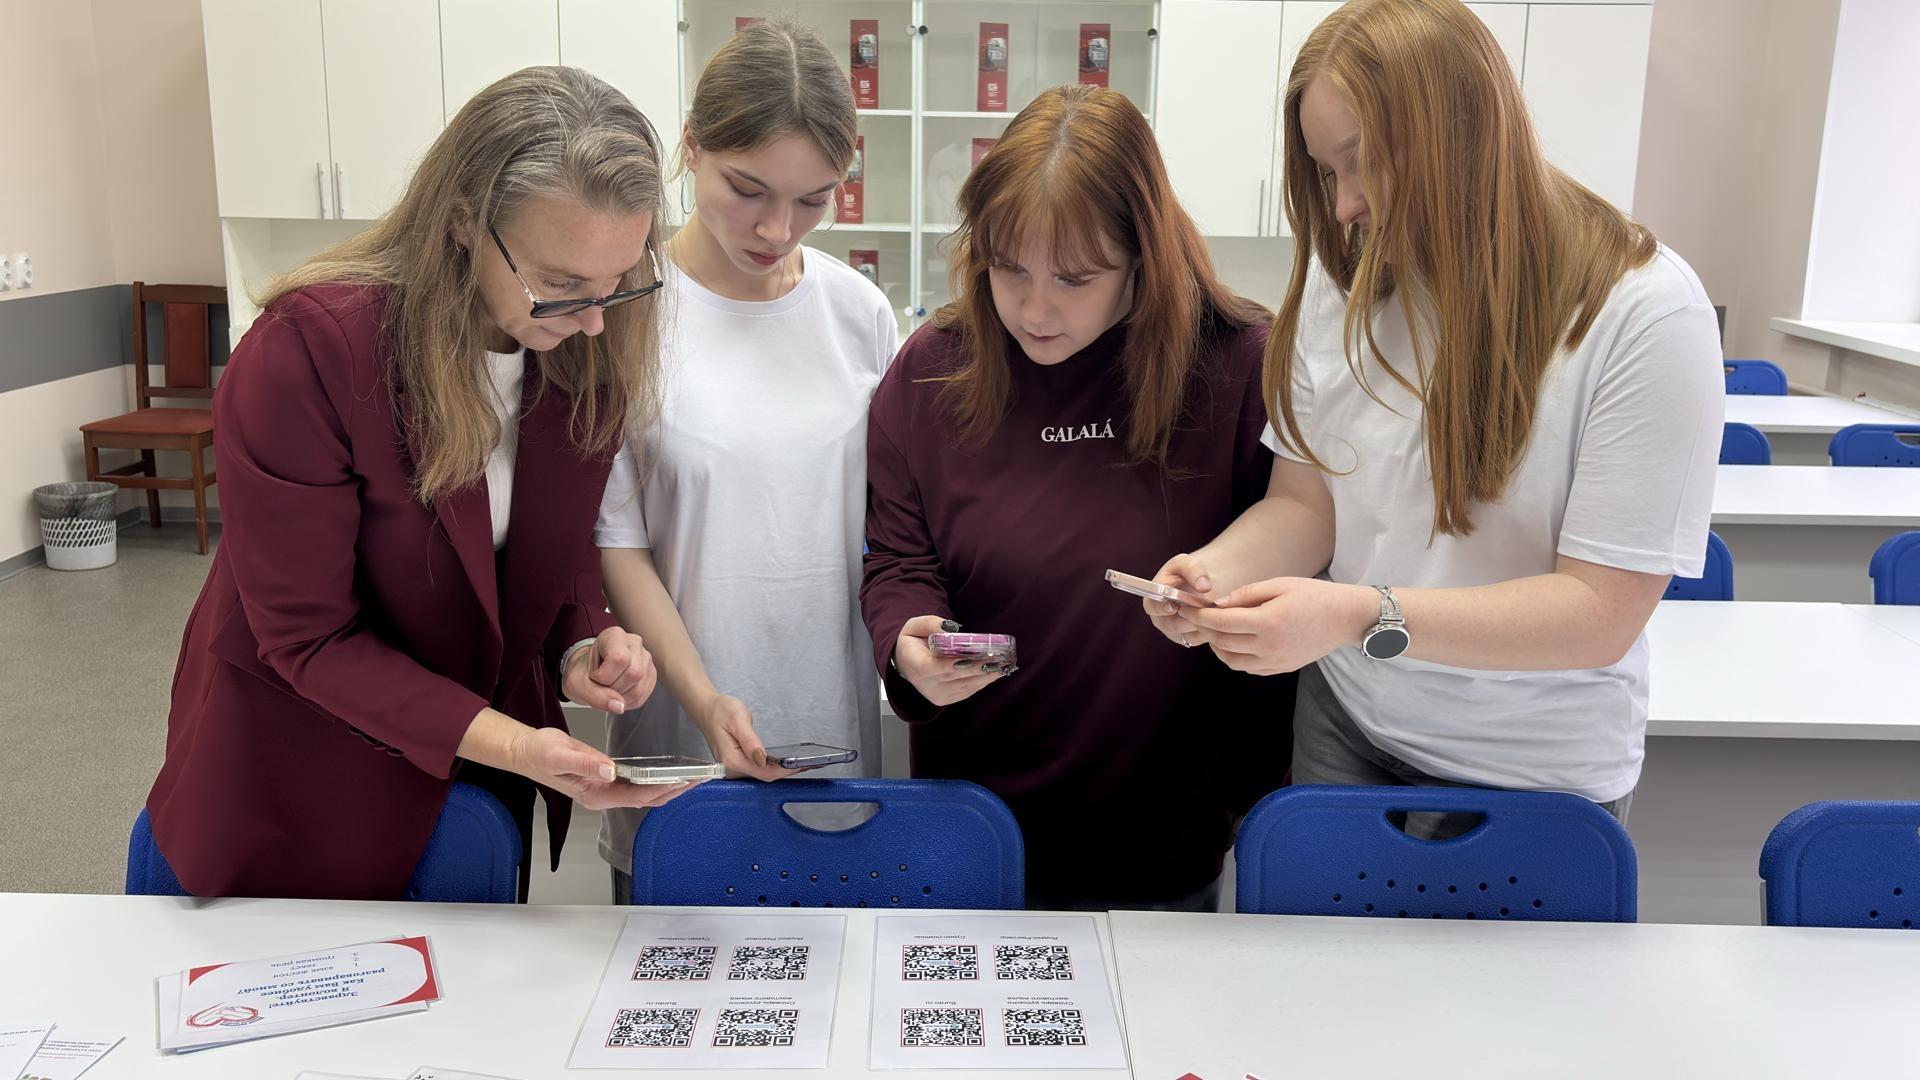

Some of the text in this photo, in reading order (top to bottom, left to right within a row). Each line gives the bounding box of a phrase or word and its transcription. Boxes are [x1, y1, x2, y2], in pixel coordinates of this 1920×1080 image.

[1041, 418, 1115, 442] GALALÁ
[297, 967, 386, 985] разговаривать
[237, 984, 277, 995] мной?
[260, 984, 312, 997] удобнее
[276, 989, 338, 1000] волонтер.
[268, 991, 358, 1009] Здравствуйте!
